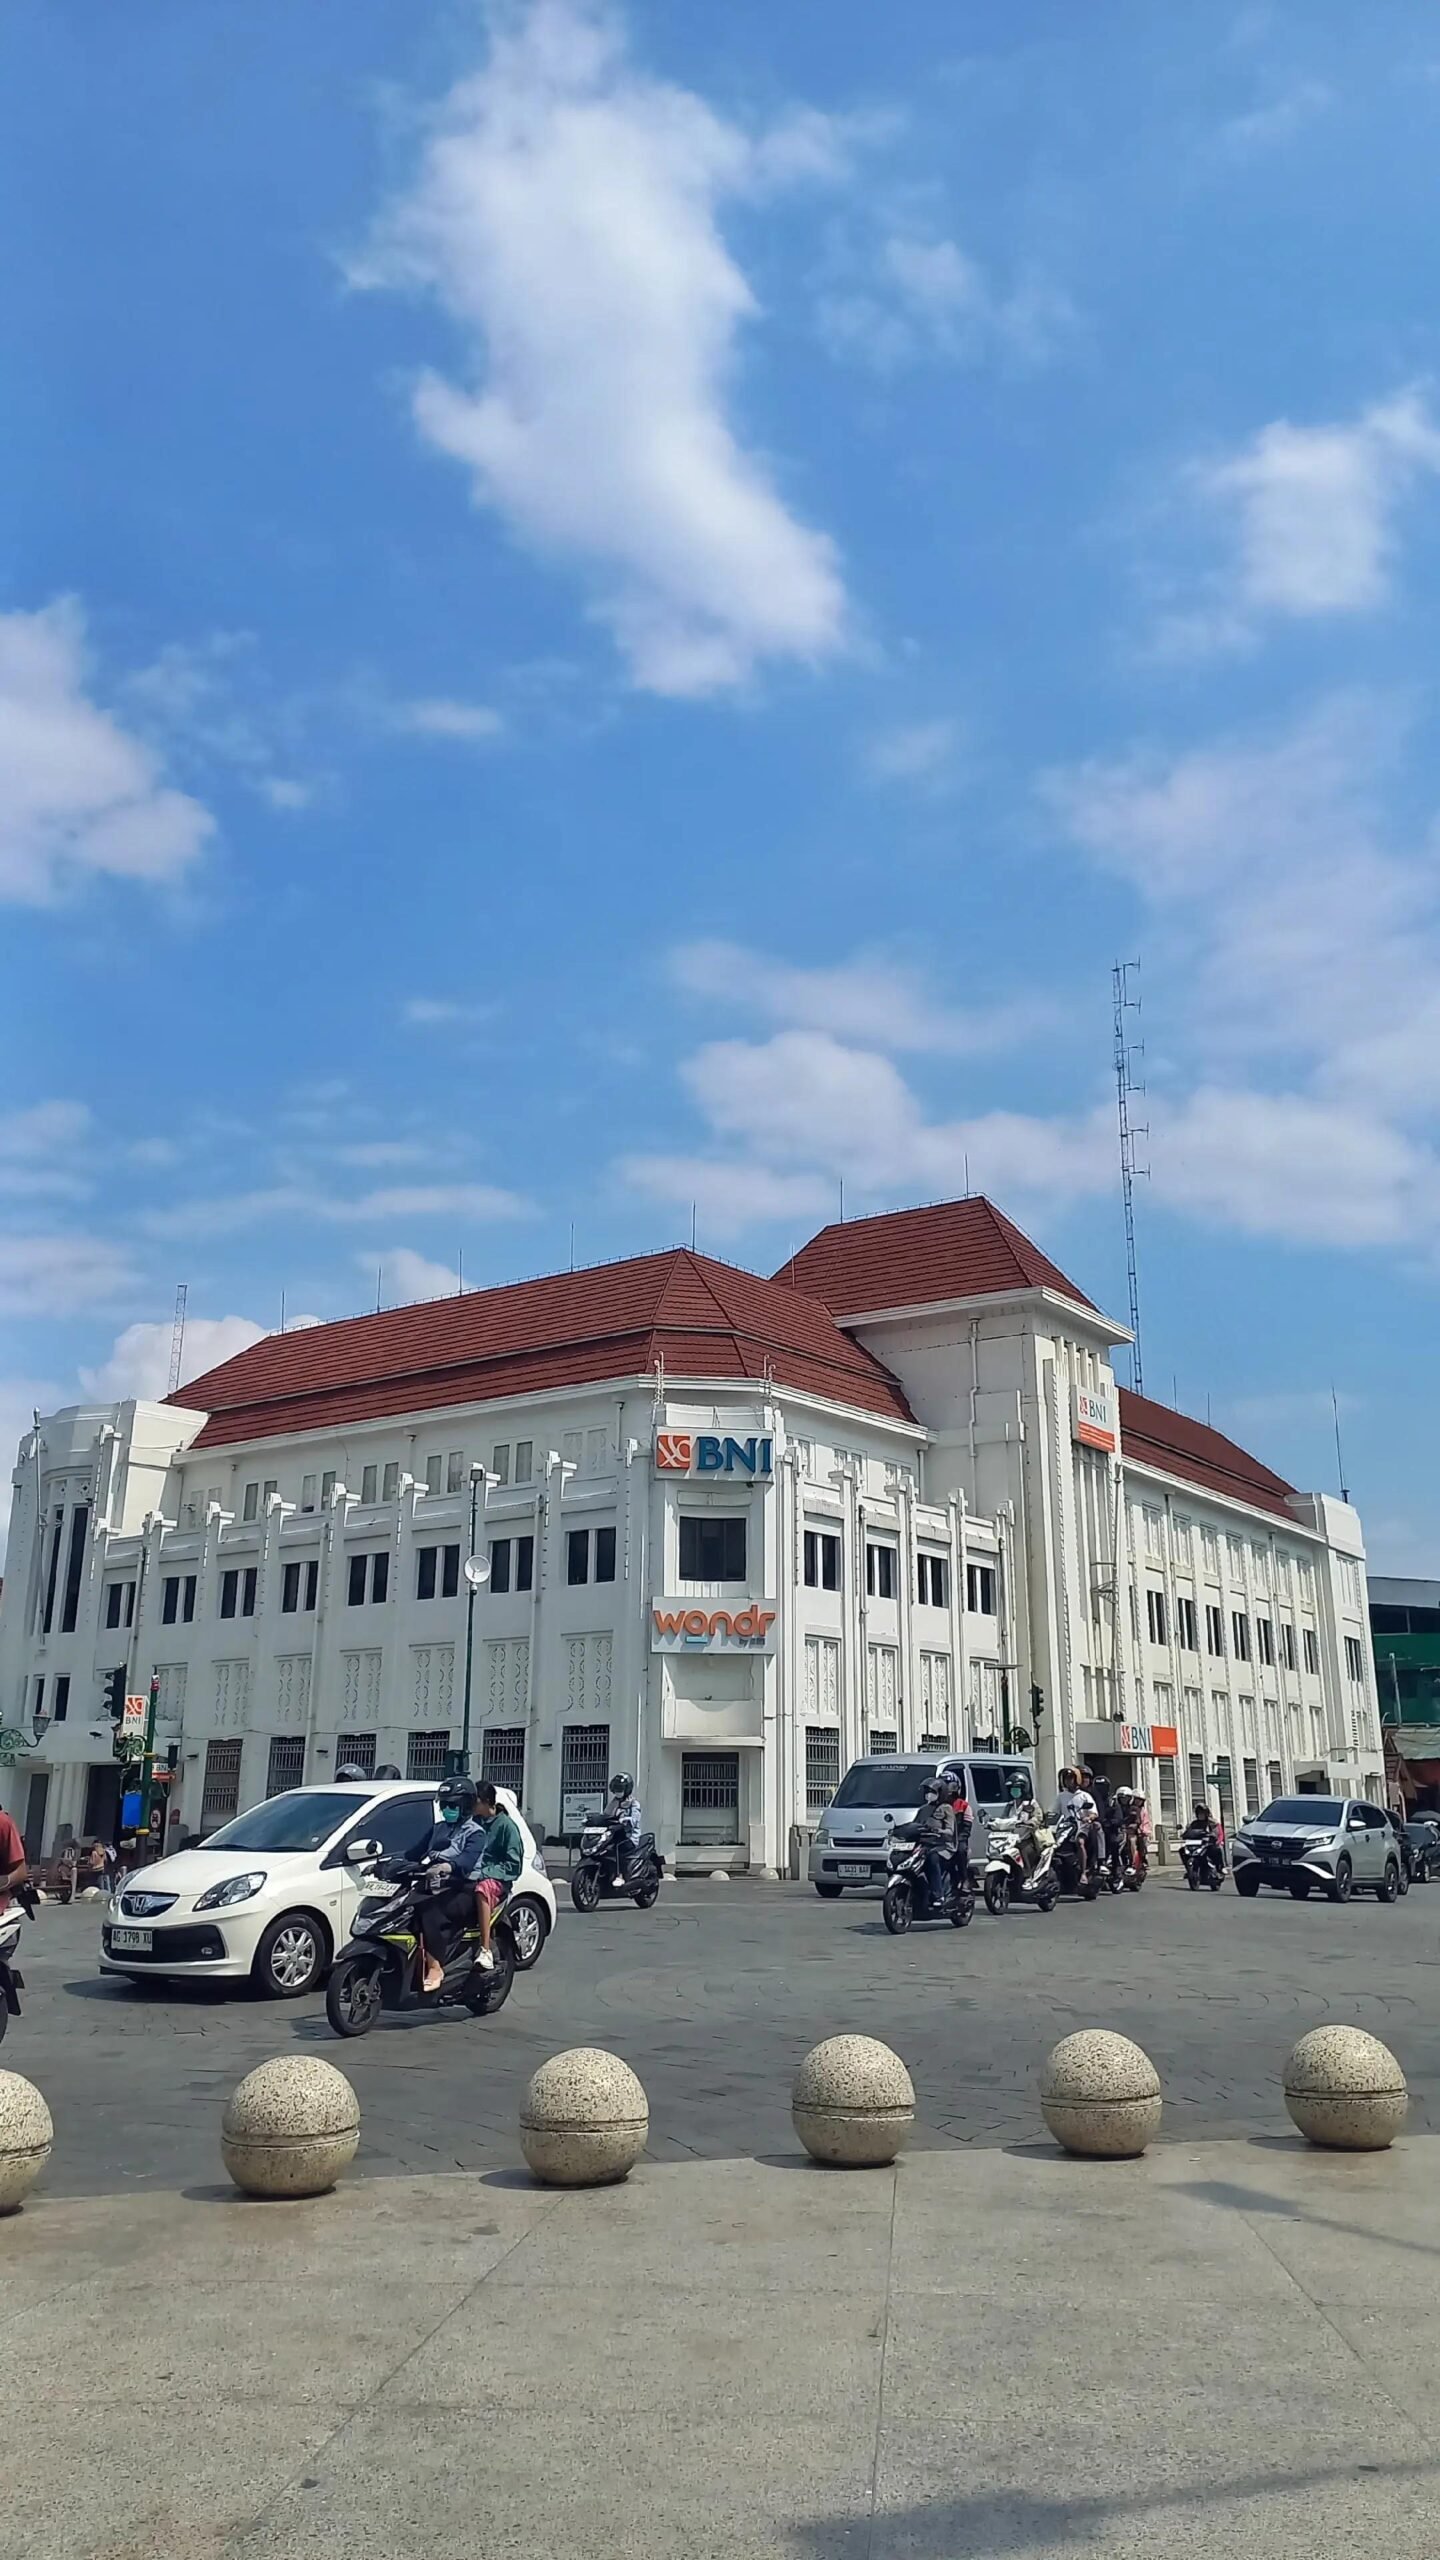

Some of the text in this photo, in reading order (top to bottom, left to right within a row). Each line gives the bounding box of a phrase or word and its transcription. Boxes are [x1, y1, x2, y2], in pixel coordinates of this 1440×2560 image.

[1089, 1399, 1106, 1424] BNI
[696, 1436, 773, 1473] BNI
[653, 1604, 776, 1637] wondr
[125, 1716, 141, 1725] BNI
[1131, 1726, 1152, 1752] BNI
